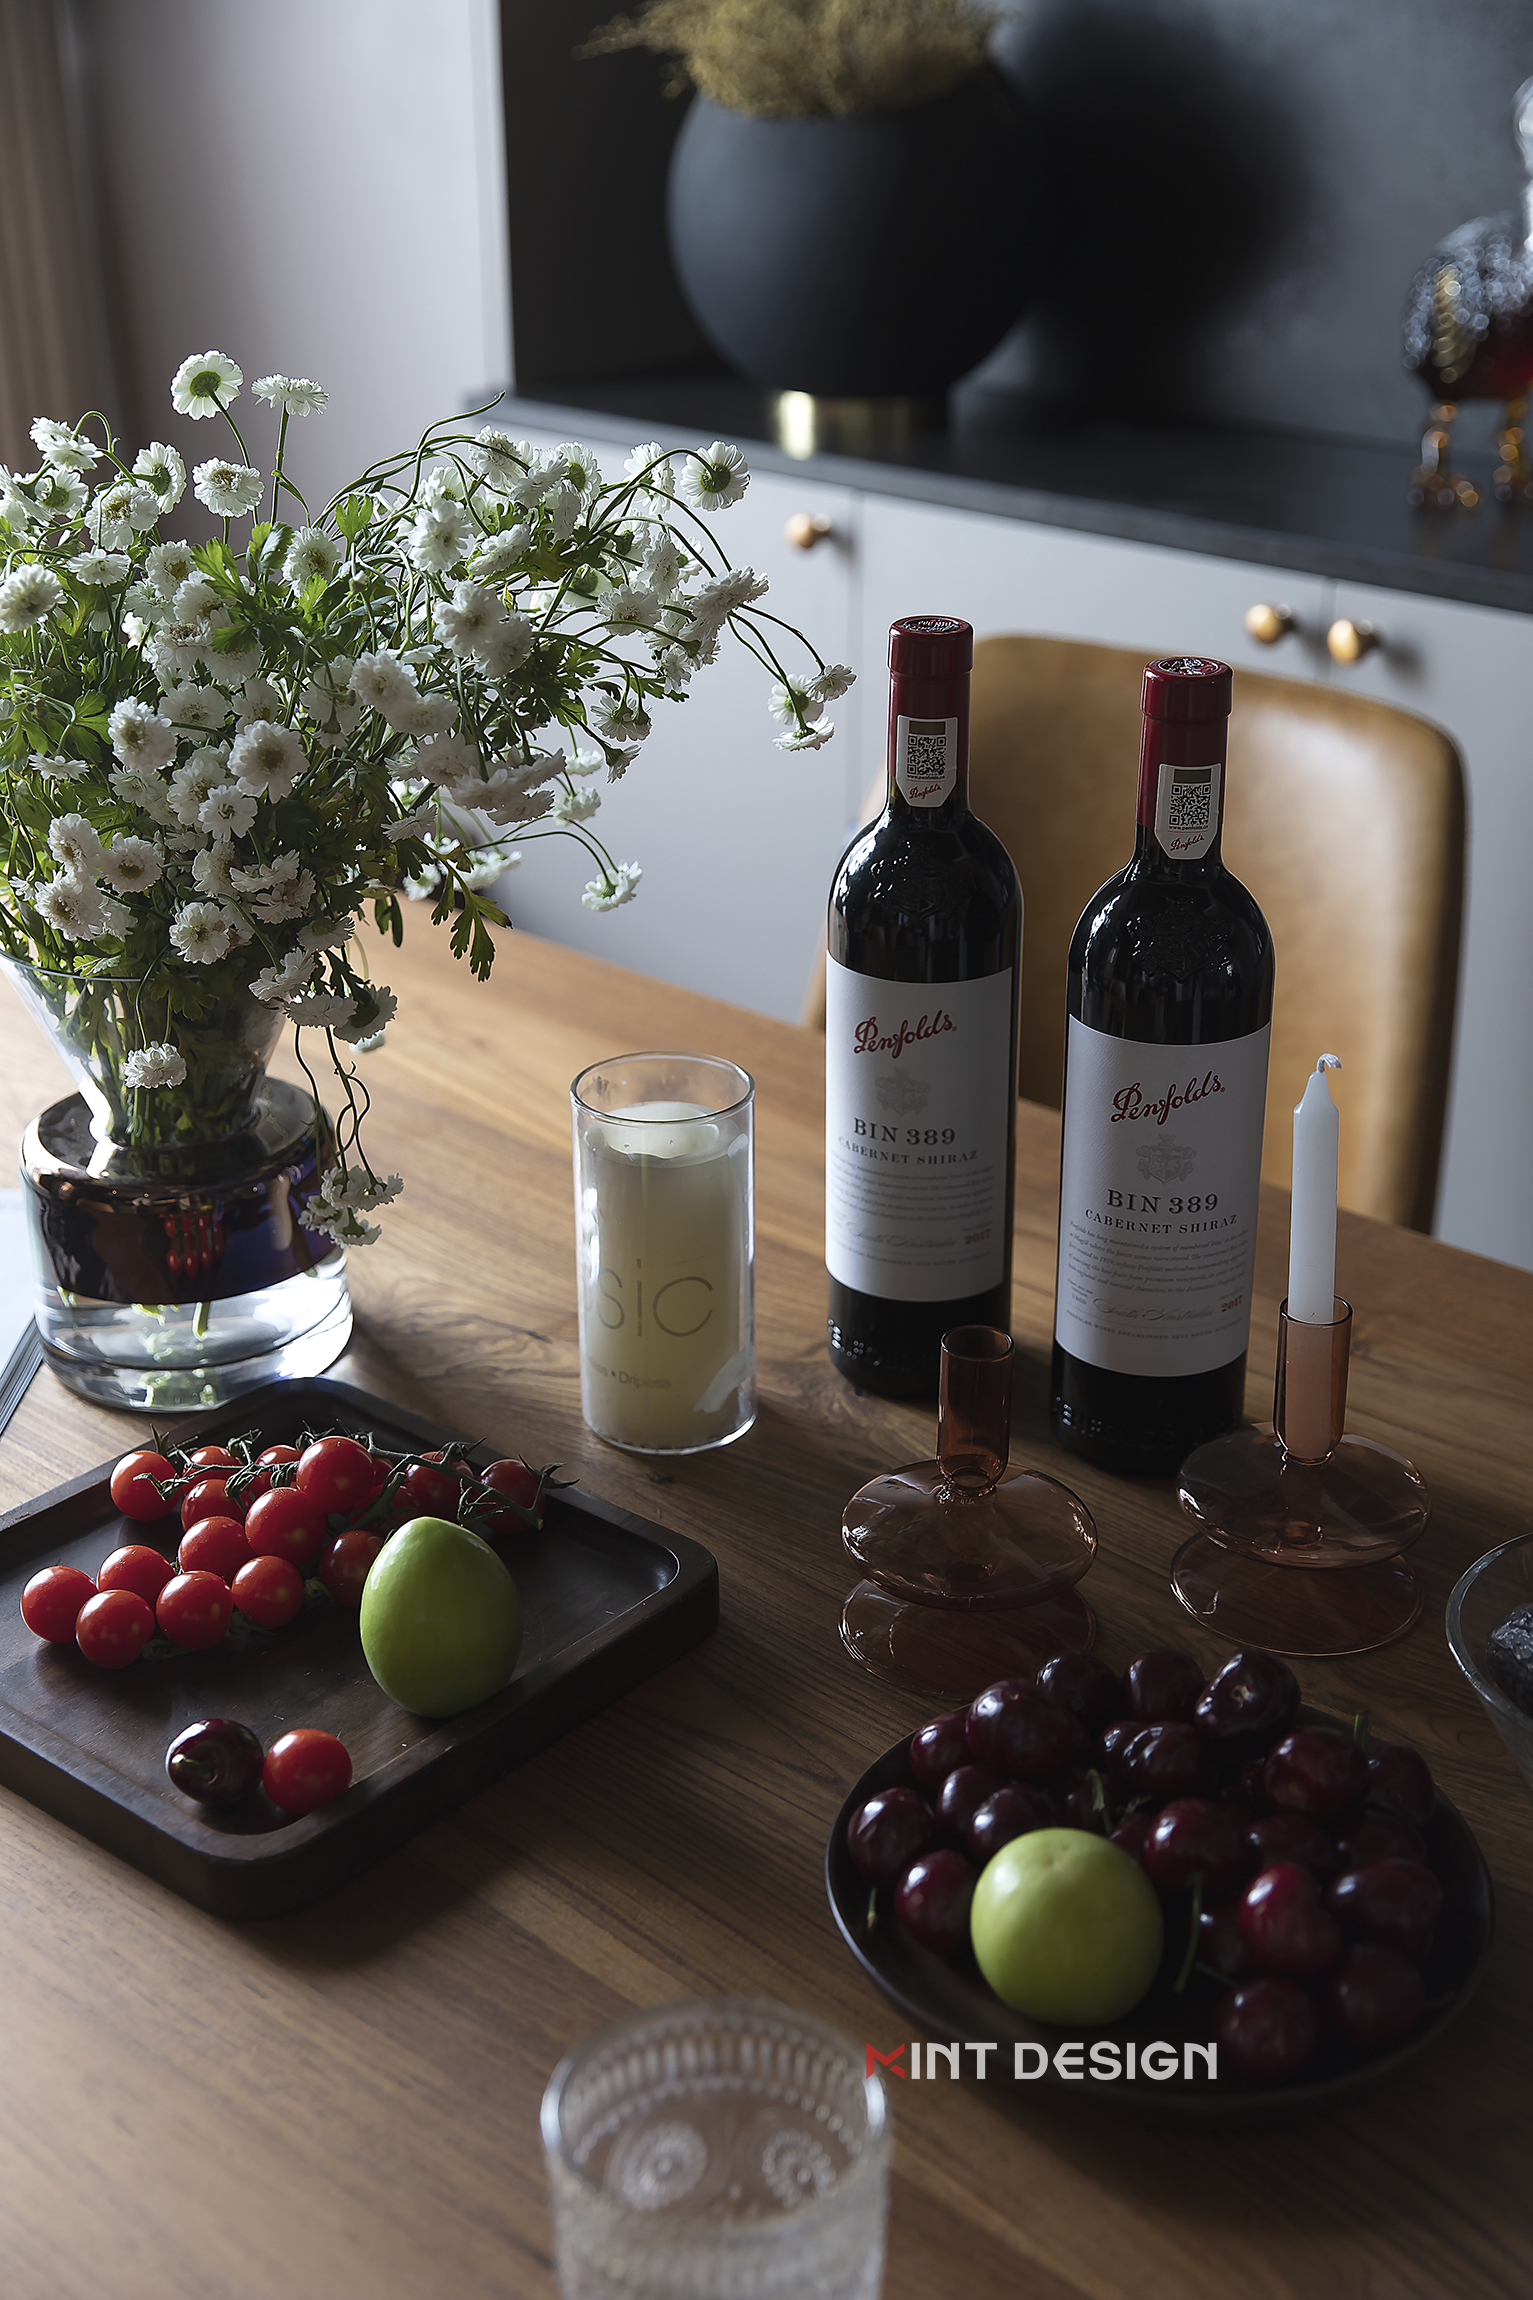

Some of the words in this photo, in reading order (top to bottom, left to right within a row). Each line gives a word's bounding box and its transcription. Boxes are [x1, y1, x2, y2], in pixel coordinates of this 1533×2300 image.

[853, 1009, 954, 1059] Penfolds
[1110, 1070, 1222, 1126] Penfolds
[854, 1116, 900, 1143] BIN
[906, 1128, 956, 1145] 389
[838, 1136, 911, 1164] CABERNET
[916, 1149, 979, 1166] SHIRAZ
[1106, 1188, 1162, 1214] BIN
[1168, 1193, 1219, 1214] 389
[1085, 1208, 1172, 1234] CABERNET
[1179, 1214, 1238, 1234] SHIRAZ
[1221, 1294, 1244, 1313] 2017
